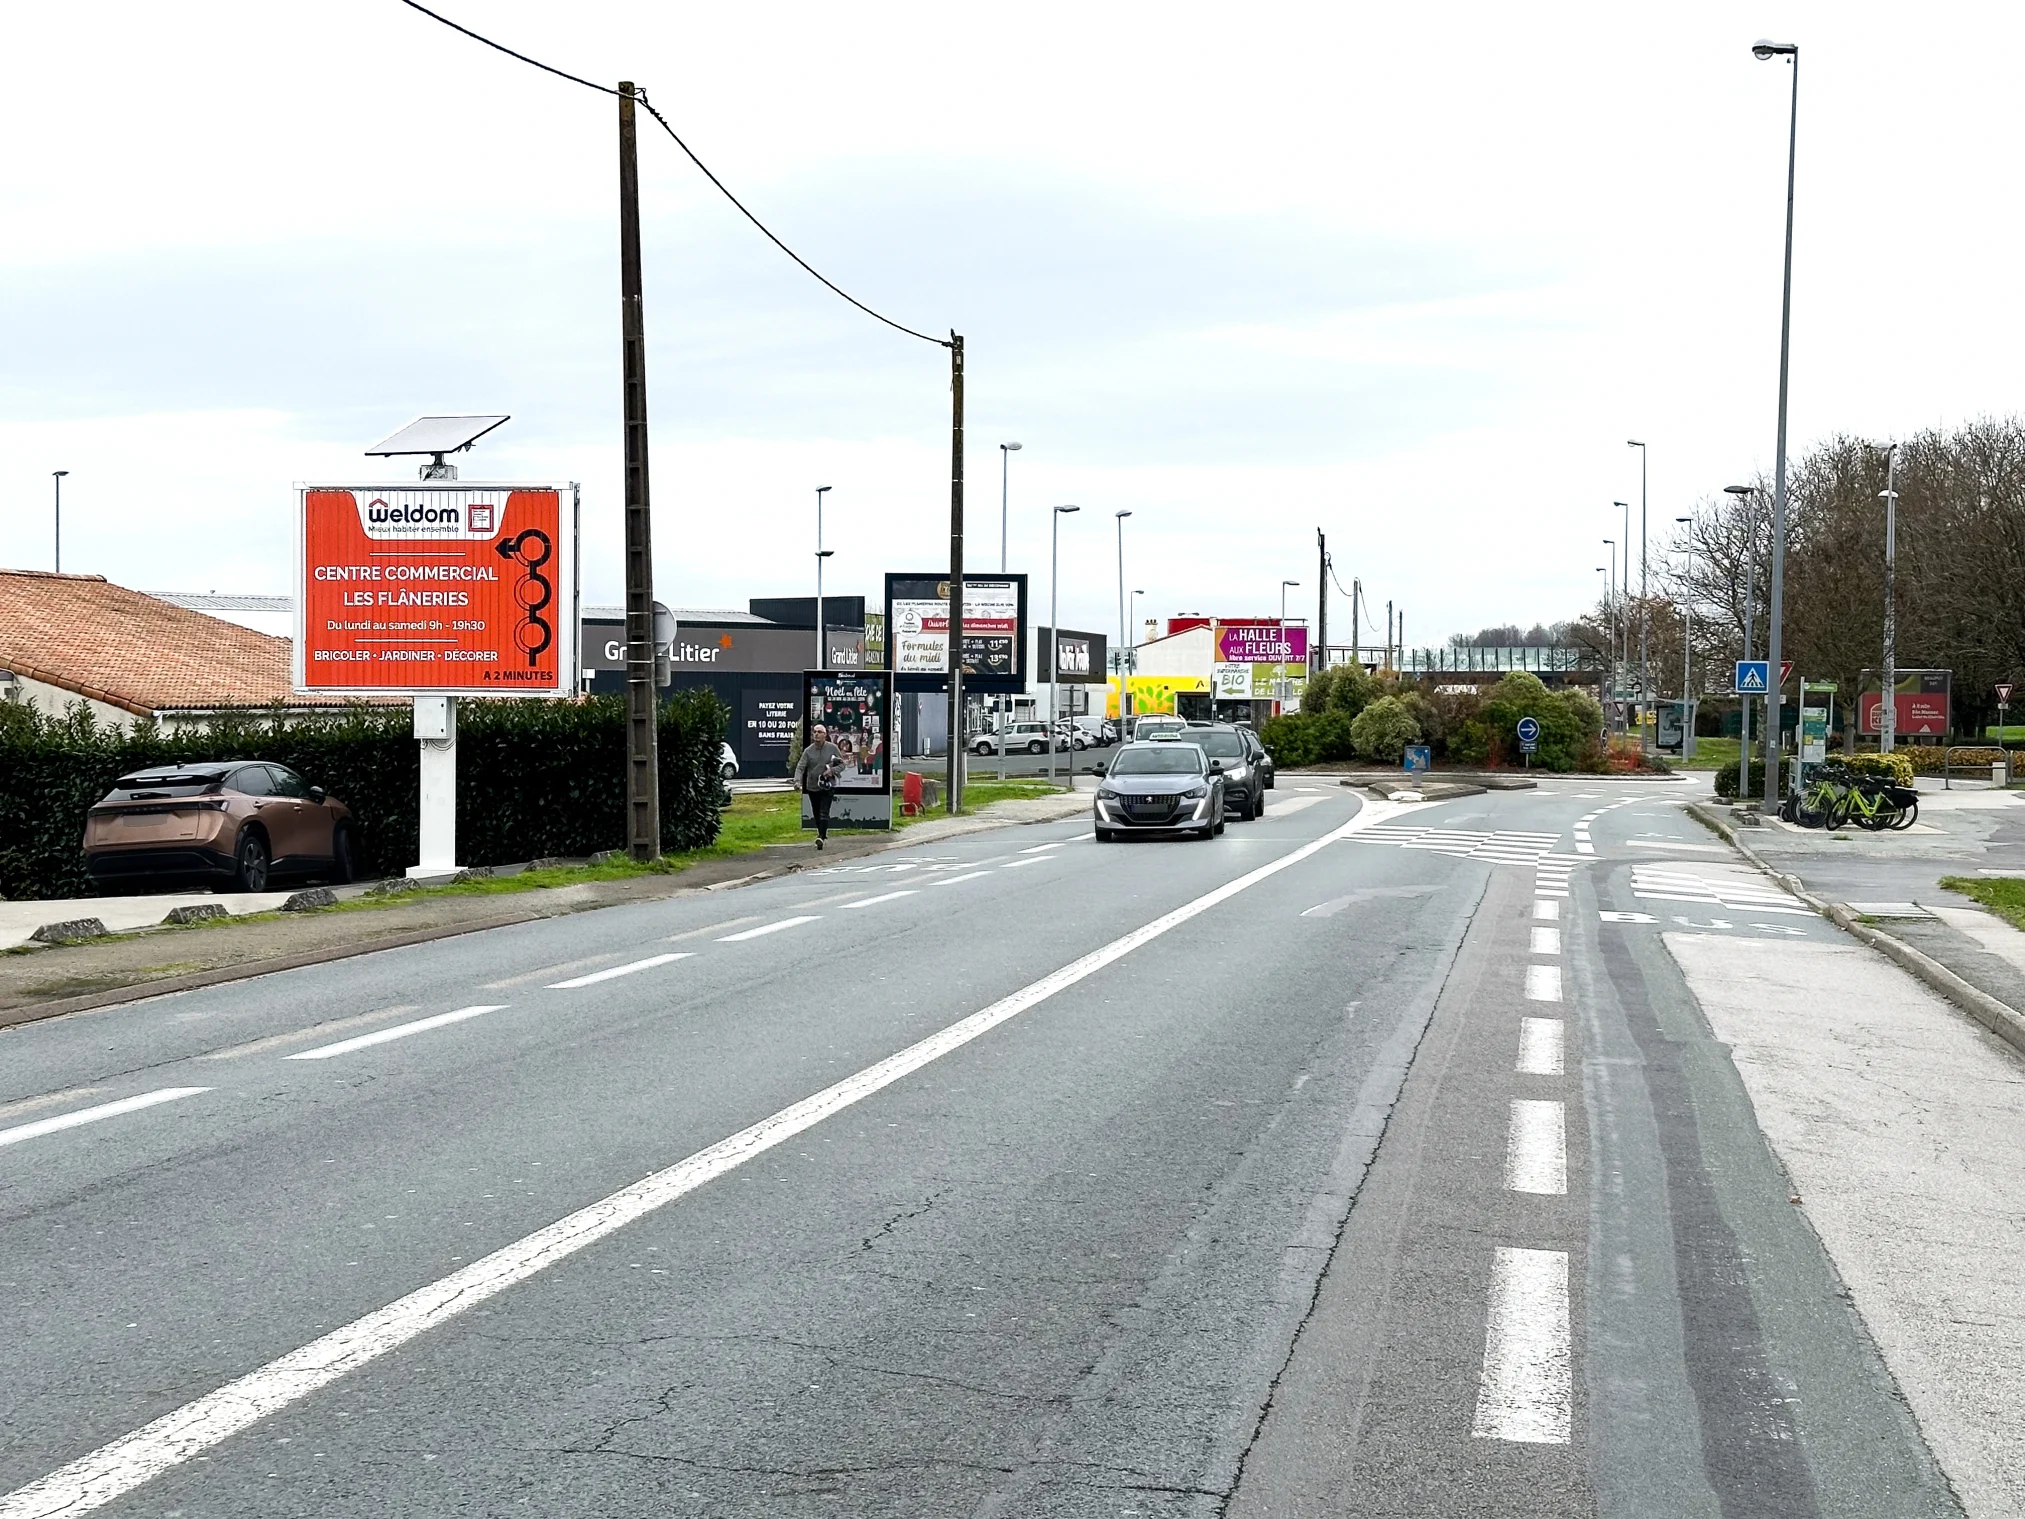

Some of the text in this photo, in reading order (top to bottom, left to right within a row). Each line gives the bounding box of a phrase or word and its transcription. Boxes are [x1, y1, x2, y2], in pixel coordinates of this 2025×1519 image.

[393, 525, 419, 533] habiter
[421, 525, 459, 533] ensemble
[314, 566, 498, 580] CENTRE COMMERCIAL
[344, 588, 468, 606] LES FLÂNERIES
[327, 620, 341, 630] Du
[345, 620, 371, 630] lundi
[373, 622, 386, 630] au
[388, 620, 426, 630] samedi
[429, 620, 443, 630] 9h
[452, 620, 485, 630] 19h30
[1239, 629, 1277, 641] HALLE
[902, 640, 943, 651] Formules
[1229, 642, 1291, 654] AUX FLEURS
[314, 648, 498, 661] BRICOLER JARDINER DÉCORER
[668, 642, 720, 662] Litier
[832, 647, 845, 664] Grand
[903, 652, 942, 662] du midi
[484, 671, 553, 680] A 2 MINUTES
[1222, 674, 1245, 686] BIO
[1598, 910, 1808, 936] BUS
